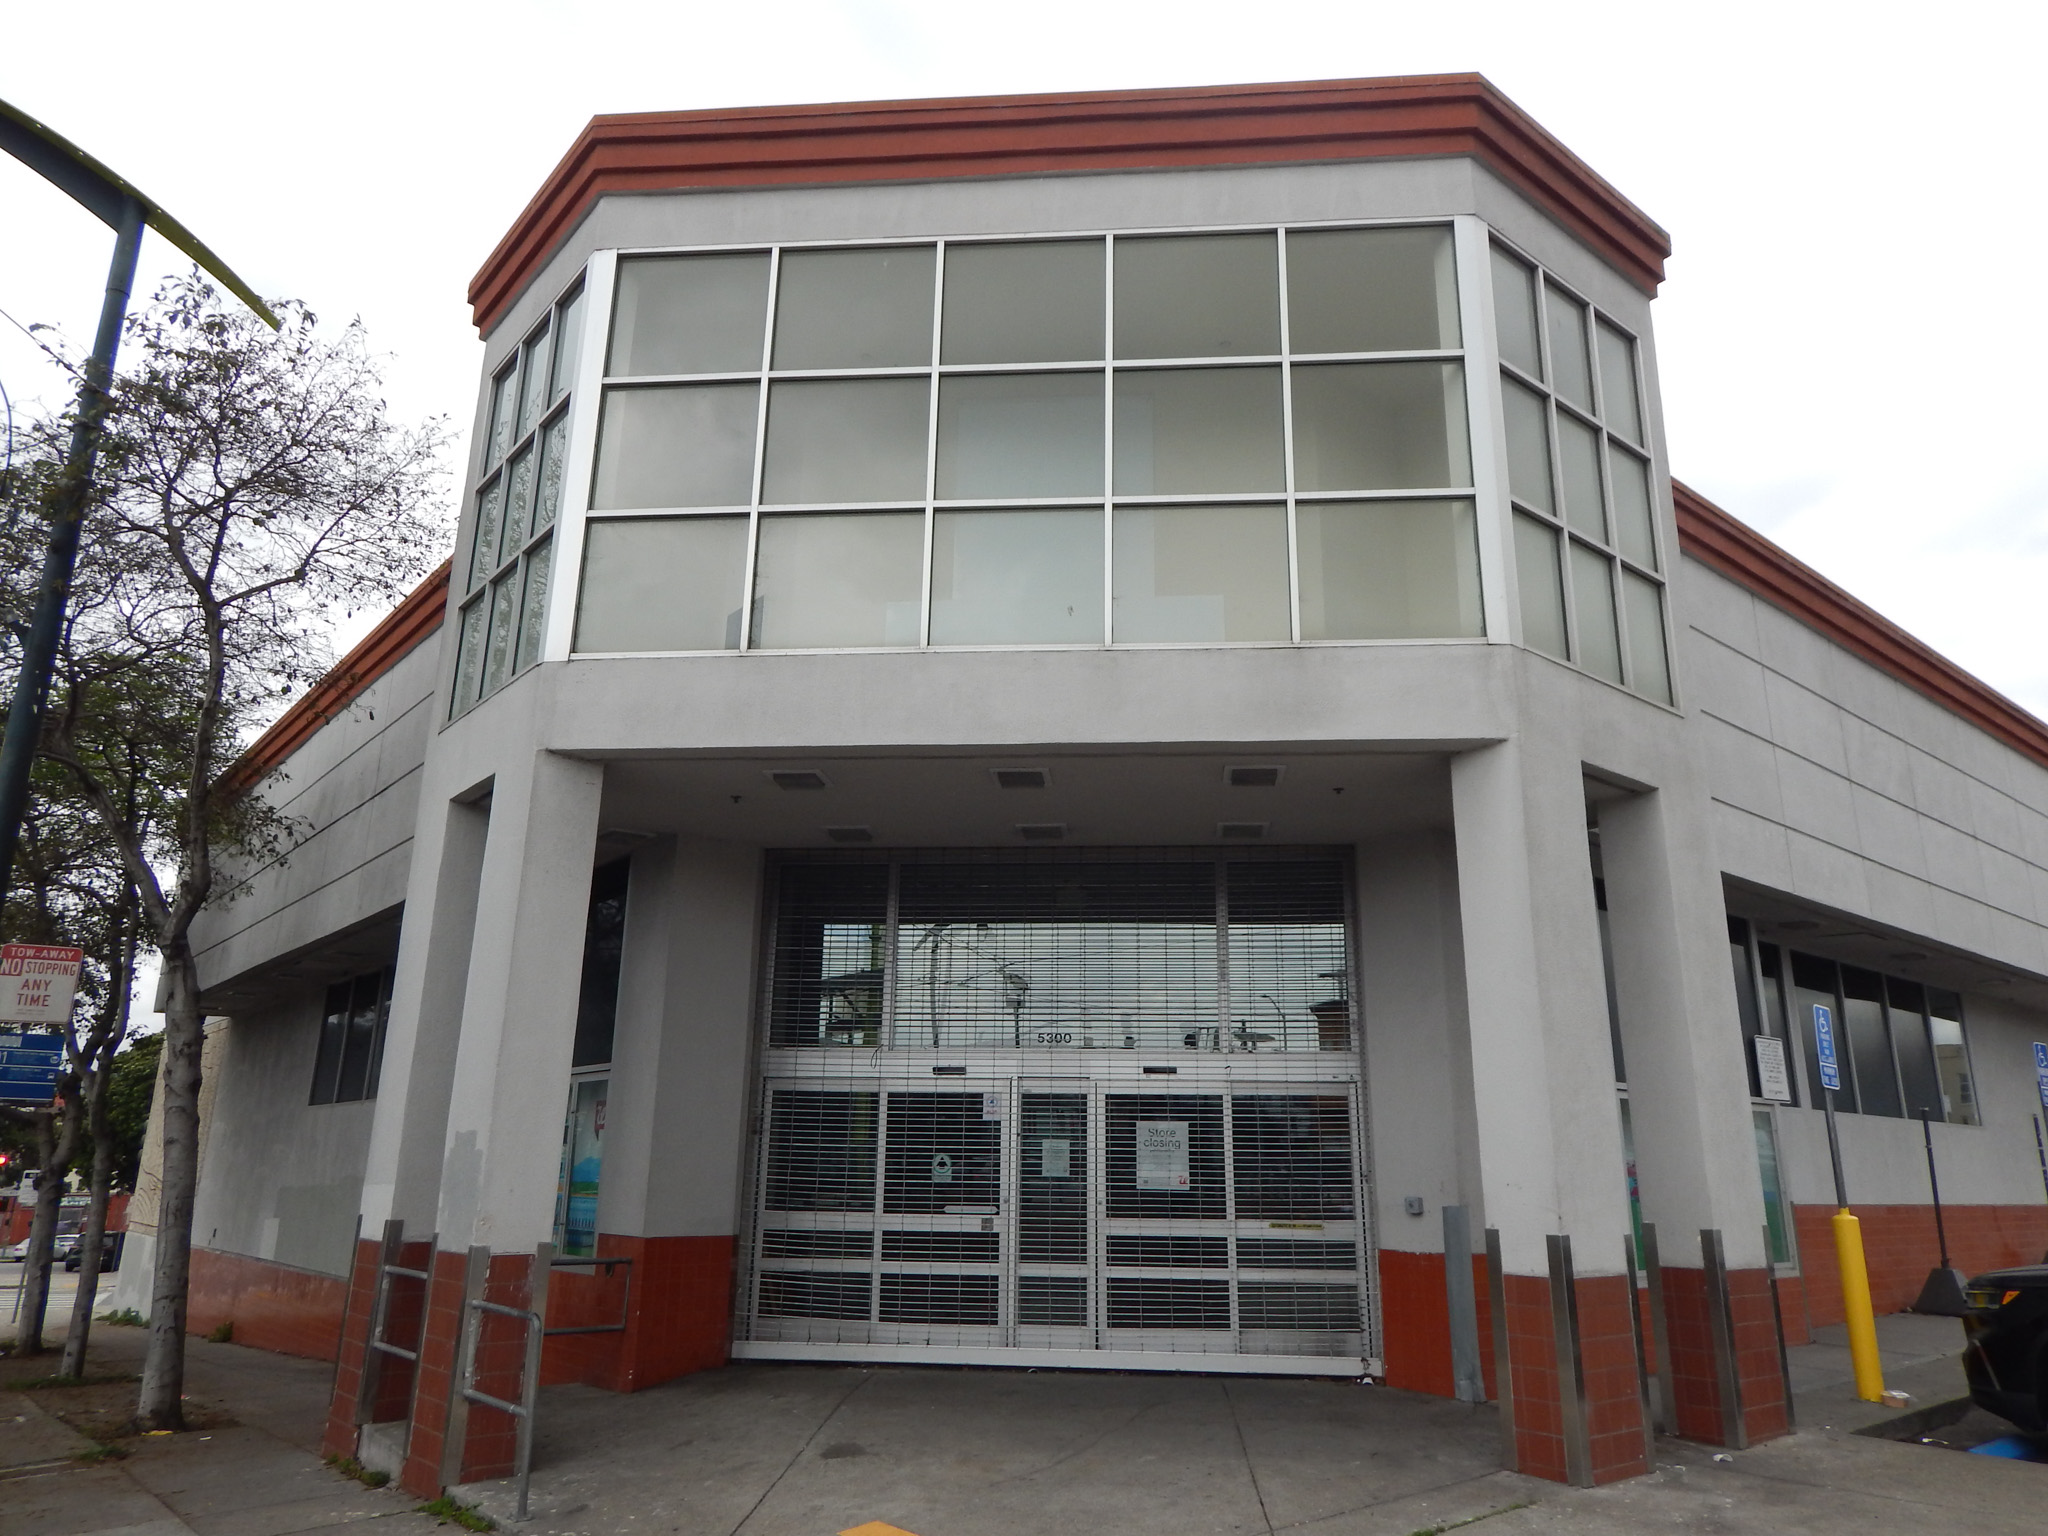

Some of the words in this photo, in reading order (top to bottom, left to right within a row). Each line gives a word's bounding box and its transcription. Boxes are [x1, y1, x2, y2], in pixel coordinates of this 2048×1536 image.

[10, 947, 75, 960] TOW-AWAY
[0, 958, 22, 975] NO
[25, 961, 77, 976] STOPPING
[21, 978, 52, 991] ANY
[17, 993, 51, 1007] TIME
[1037, 1032, 1072, 1044] 5300
[1148, 1128, 1176, 1138] Store
[1143, 1138, 1181, 1150] closing
